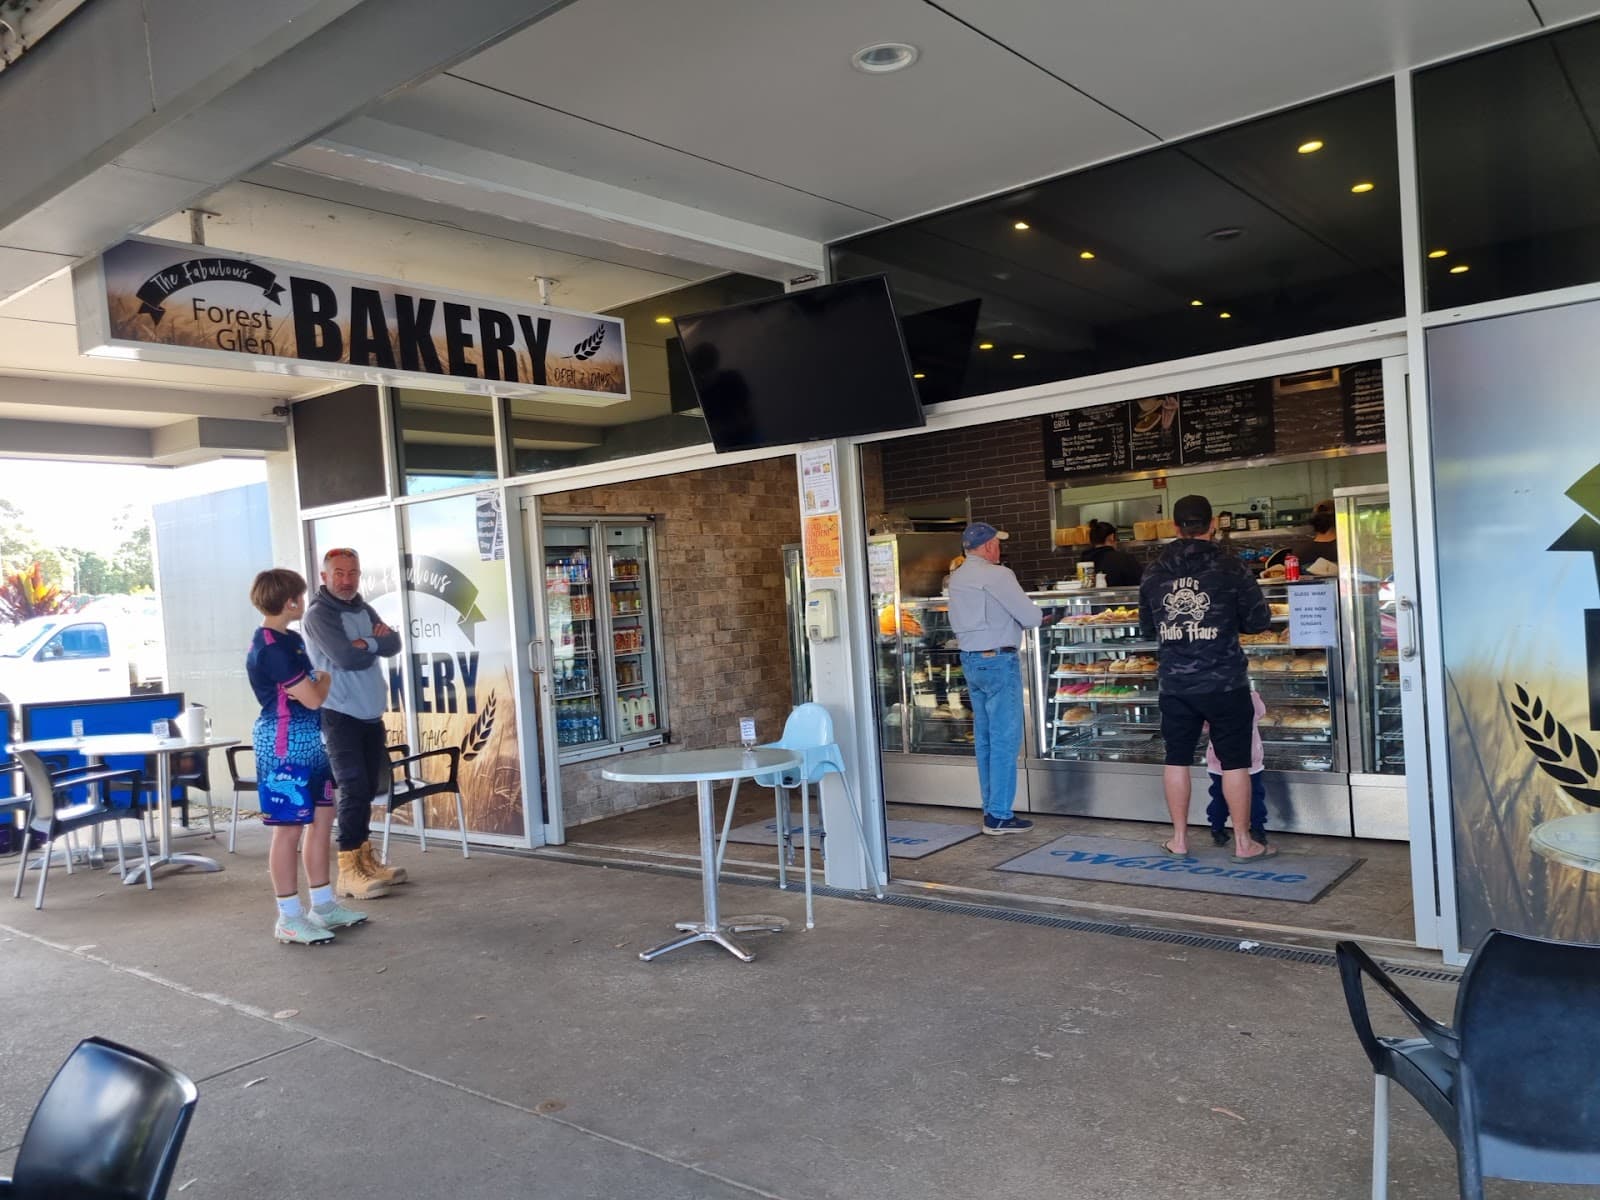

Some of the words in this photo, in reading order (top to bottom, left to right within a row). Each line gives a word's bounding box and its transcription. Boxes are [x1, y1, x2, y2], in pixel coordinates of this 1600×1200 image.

[150, 271, 179, 294] The
[182, 260, 253, 285] Fabulous
[192, 298, 274, 331] Forest
[290, 276, 551, 386] BAKERY
[216, 328, 276, 356] Glen
[410, 617, 441, 639] Glen
[1159, 621, 1184, 643] Auto
[1183, 620, 1219, 643] Haus
[388, 651, 480, 714] KERY
[1050, 849, 1308, 884] Welcome
